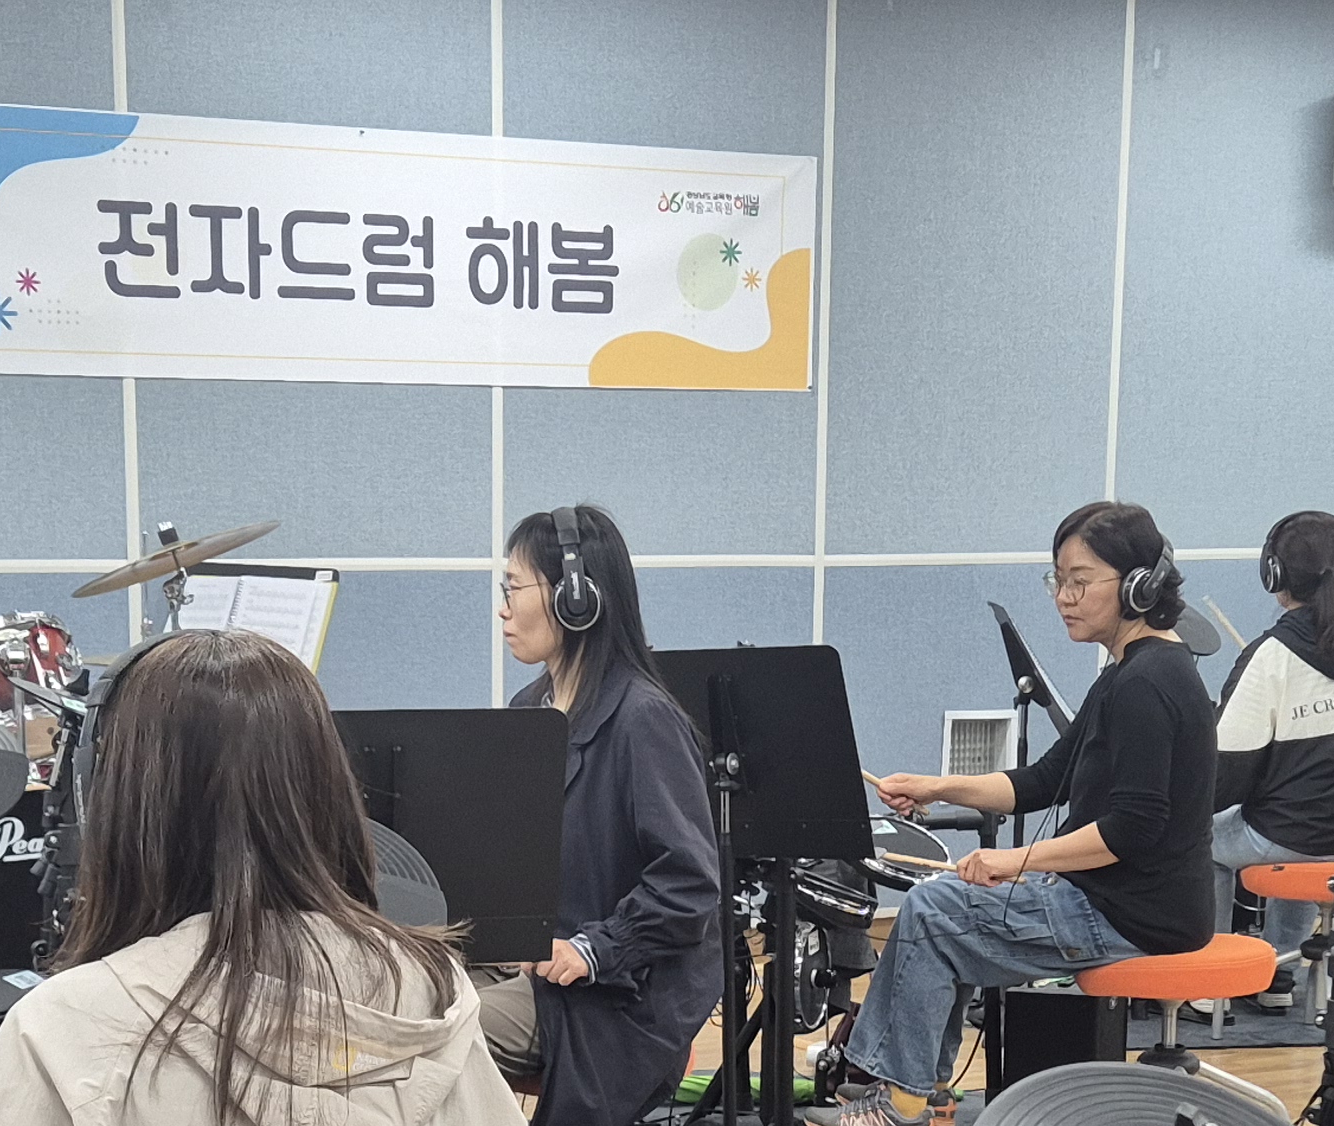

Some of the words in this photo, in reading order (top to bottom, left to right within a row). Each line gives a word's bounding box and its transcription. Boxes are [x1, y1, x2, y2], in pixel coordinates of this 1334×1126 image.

[98, 200, 435, 308] 전자드럼
[466, 216, 619, 313] 해봄
[1291, 704, 1310, 721] JE
